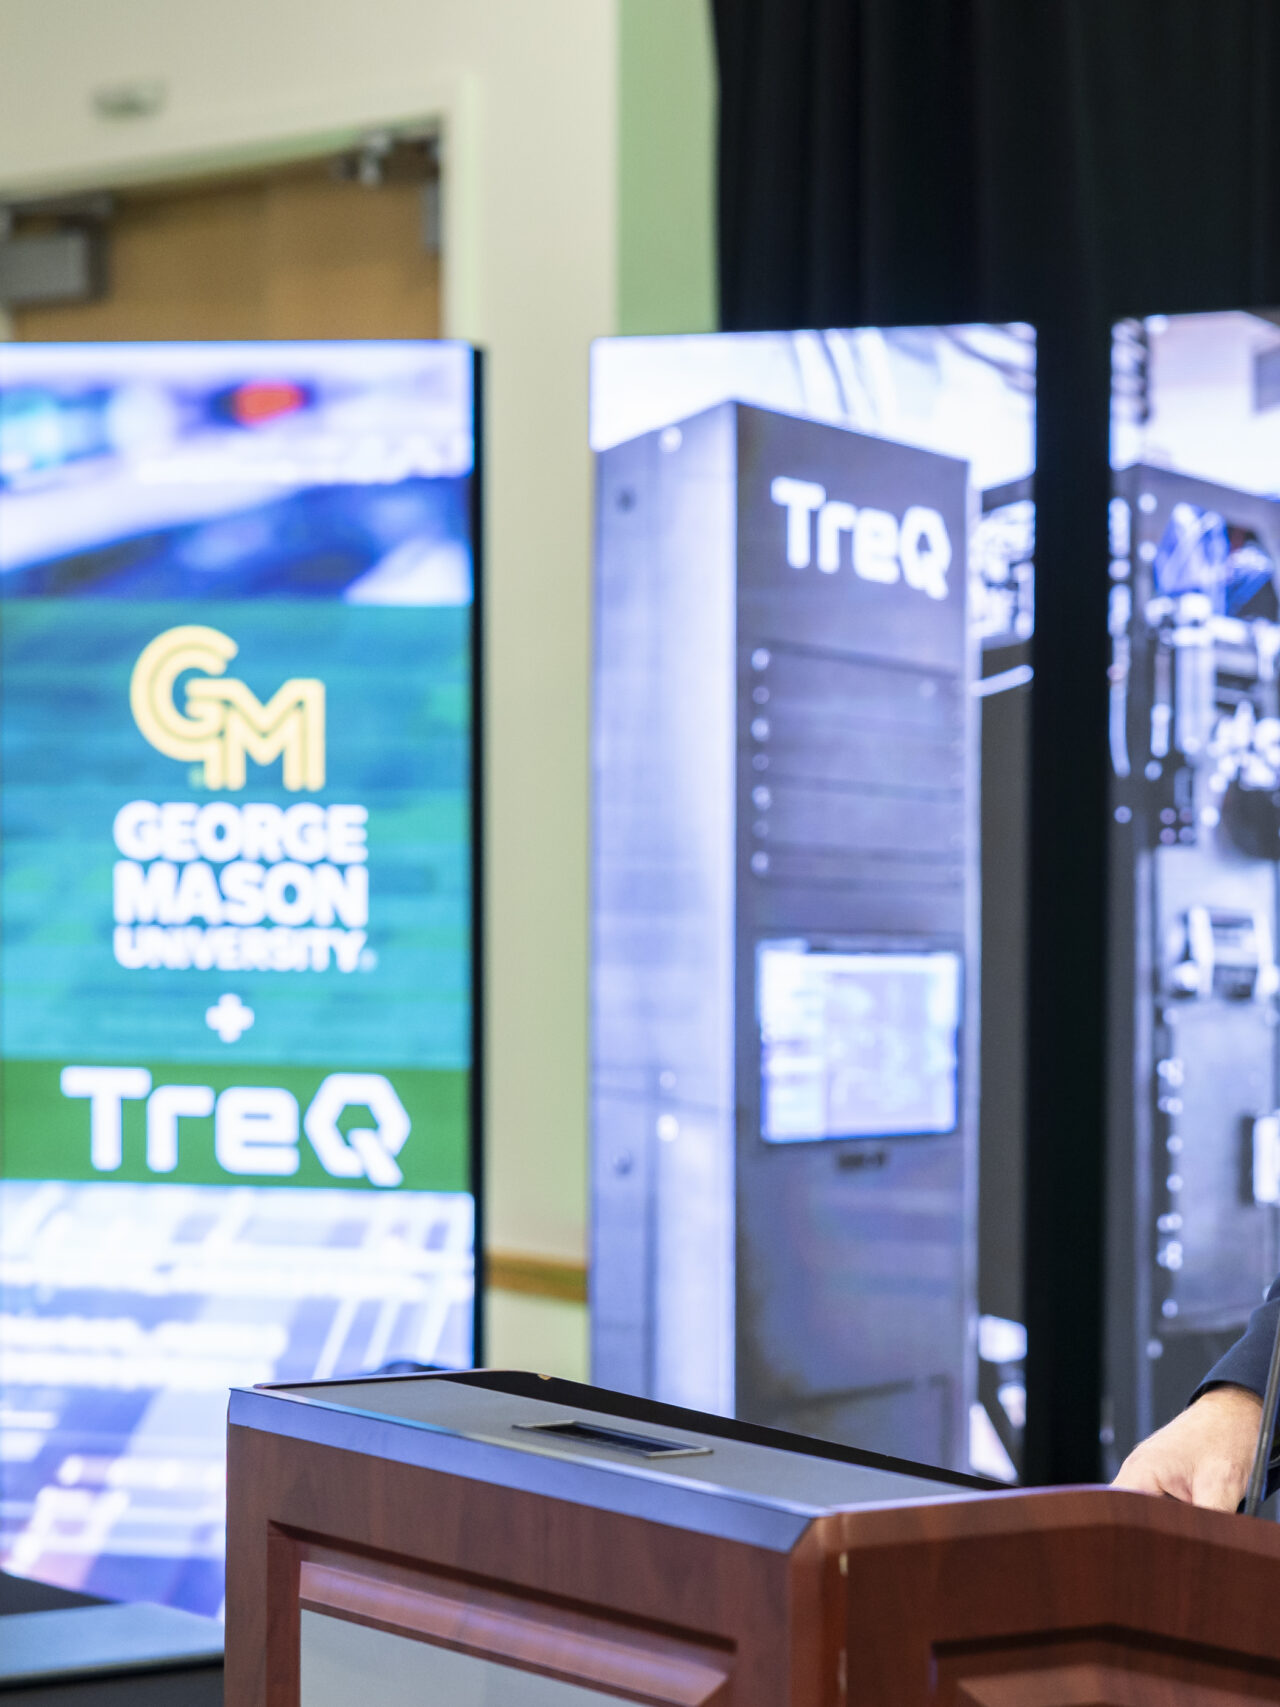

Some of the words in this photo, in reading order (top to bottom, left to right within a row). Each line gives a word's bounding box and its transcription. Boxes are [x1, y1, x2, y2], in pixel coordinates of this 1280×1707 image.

[770, 475, 952, 601] TreQ
[129, 625, 326, 792] GM
[113, 800, 369, 863] GEORGE
[113, 860, 369, 929] MASON
[113, 924, 368, 973] UNIVERSITY
[60, 1065, 411, 1188] TreQ
